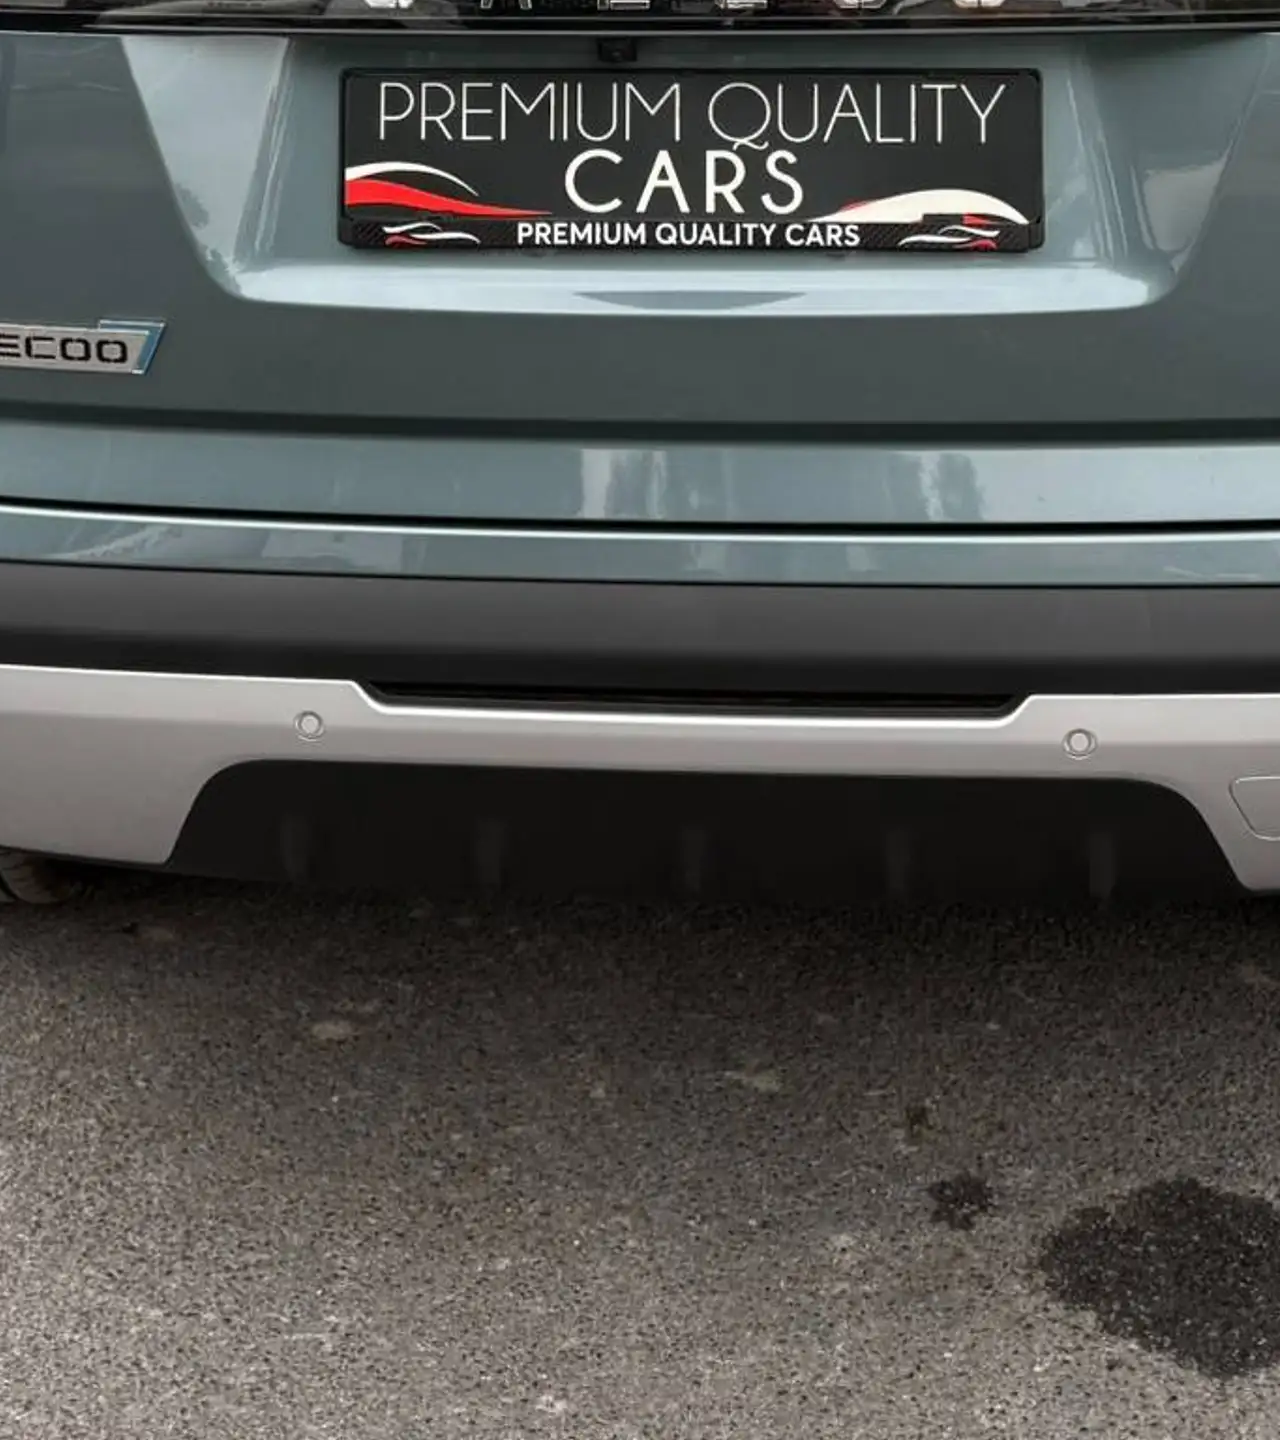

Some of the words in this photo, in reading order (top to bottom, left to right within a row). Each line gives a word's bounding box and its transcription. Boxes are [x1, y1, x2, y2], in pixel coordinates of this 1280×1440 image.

[379, 82, 682, 144] PREMIUM
[708, 82, 1007, 151] QUALITY
[564, 148, 804, 215] CARS
[517, 222, 647, 247] PREMIUM
[655, 223, 778, 248] QUALITY
[787, 224, 862, 249] CARS
